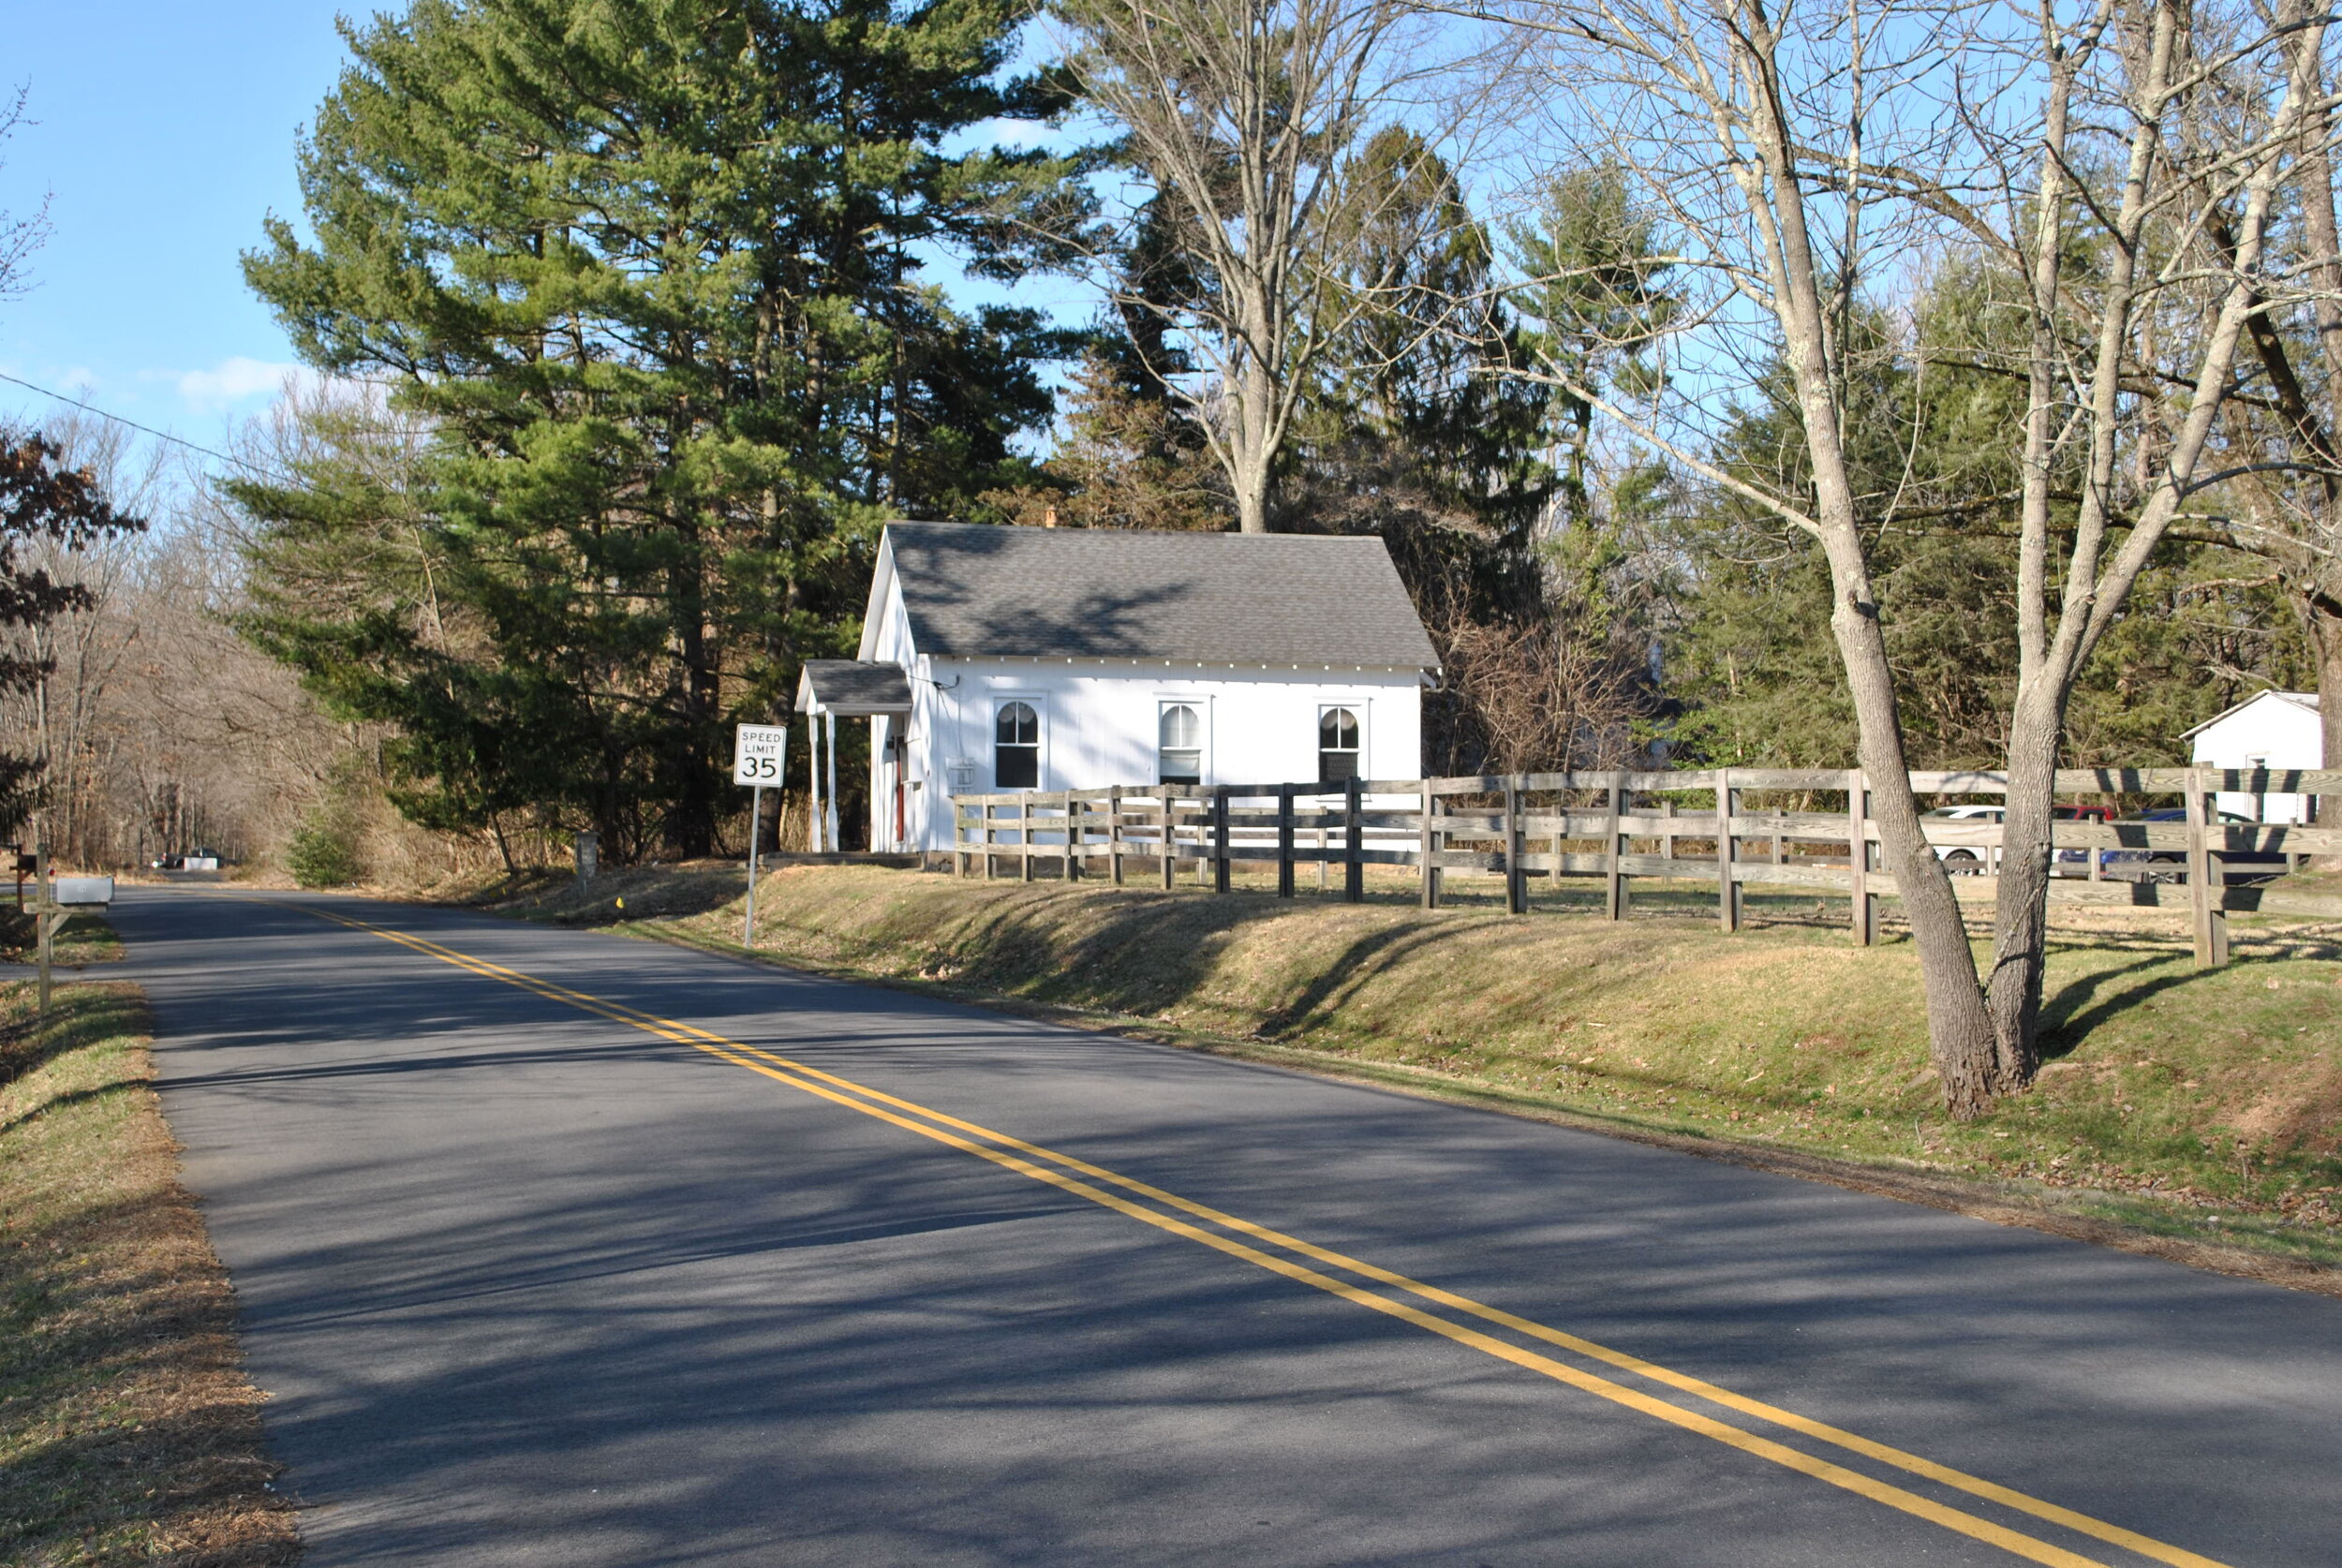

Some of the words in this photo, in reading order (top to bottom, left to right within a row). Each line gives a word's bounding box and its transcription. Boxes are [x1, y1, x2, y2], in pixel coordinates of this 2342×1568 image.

[742, 732, 781, 743] SPEED
[745, 744, 777, 755] LIMIT
[742, 756, 777, 778] 35
